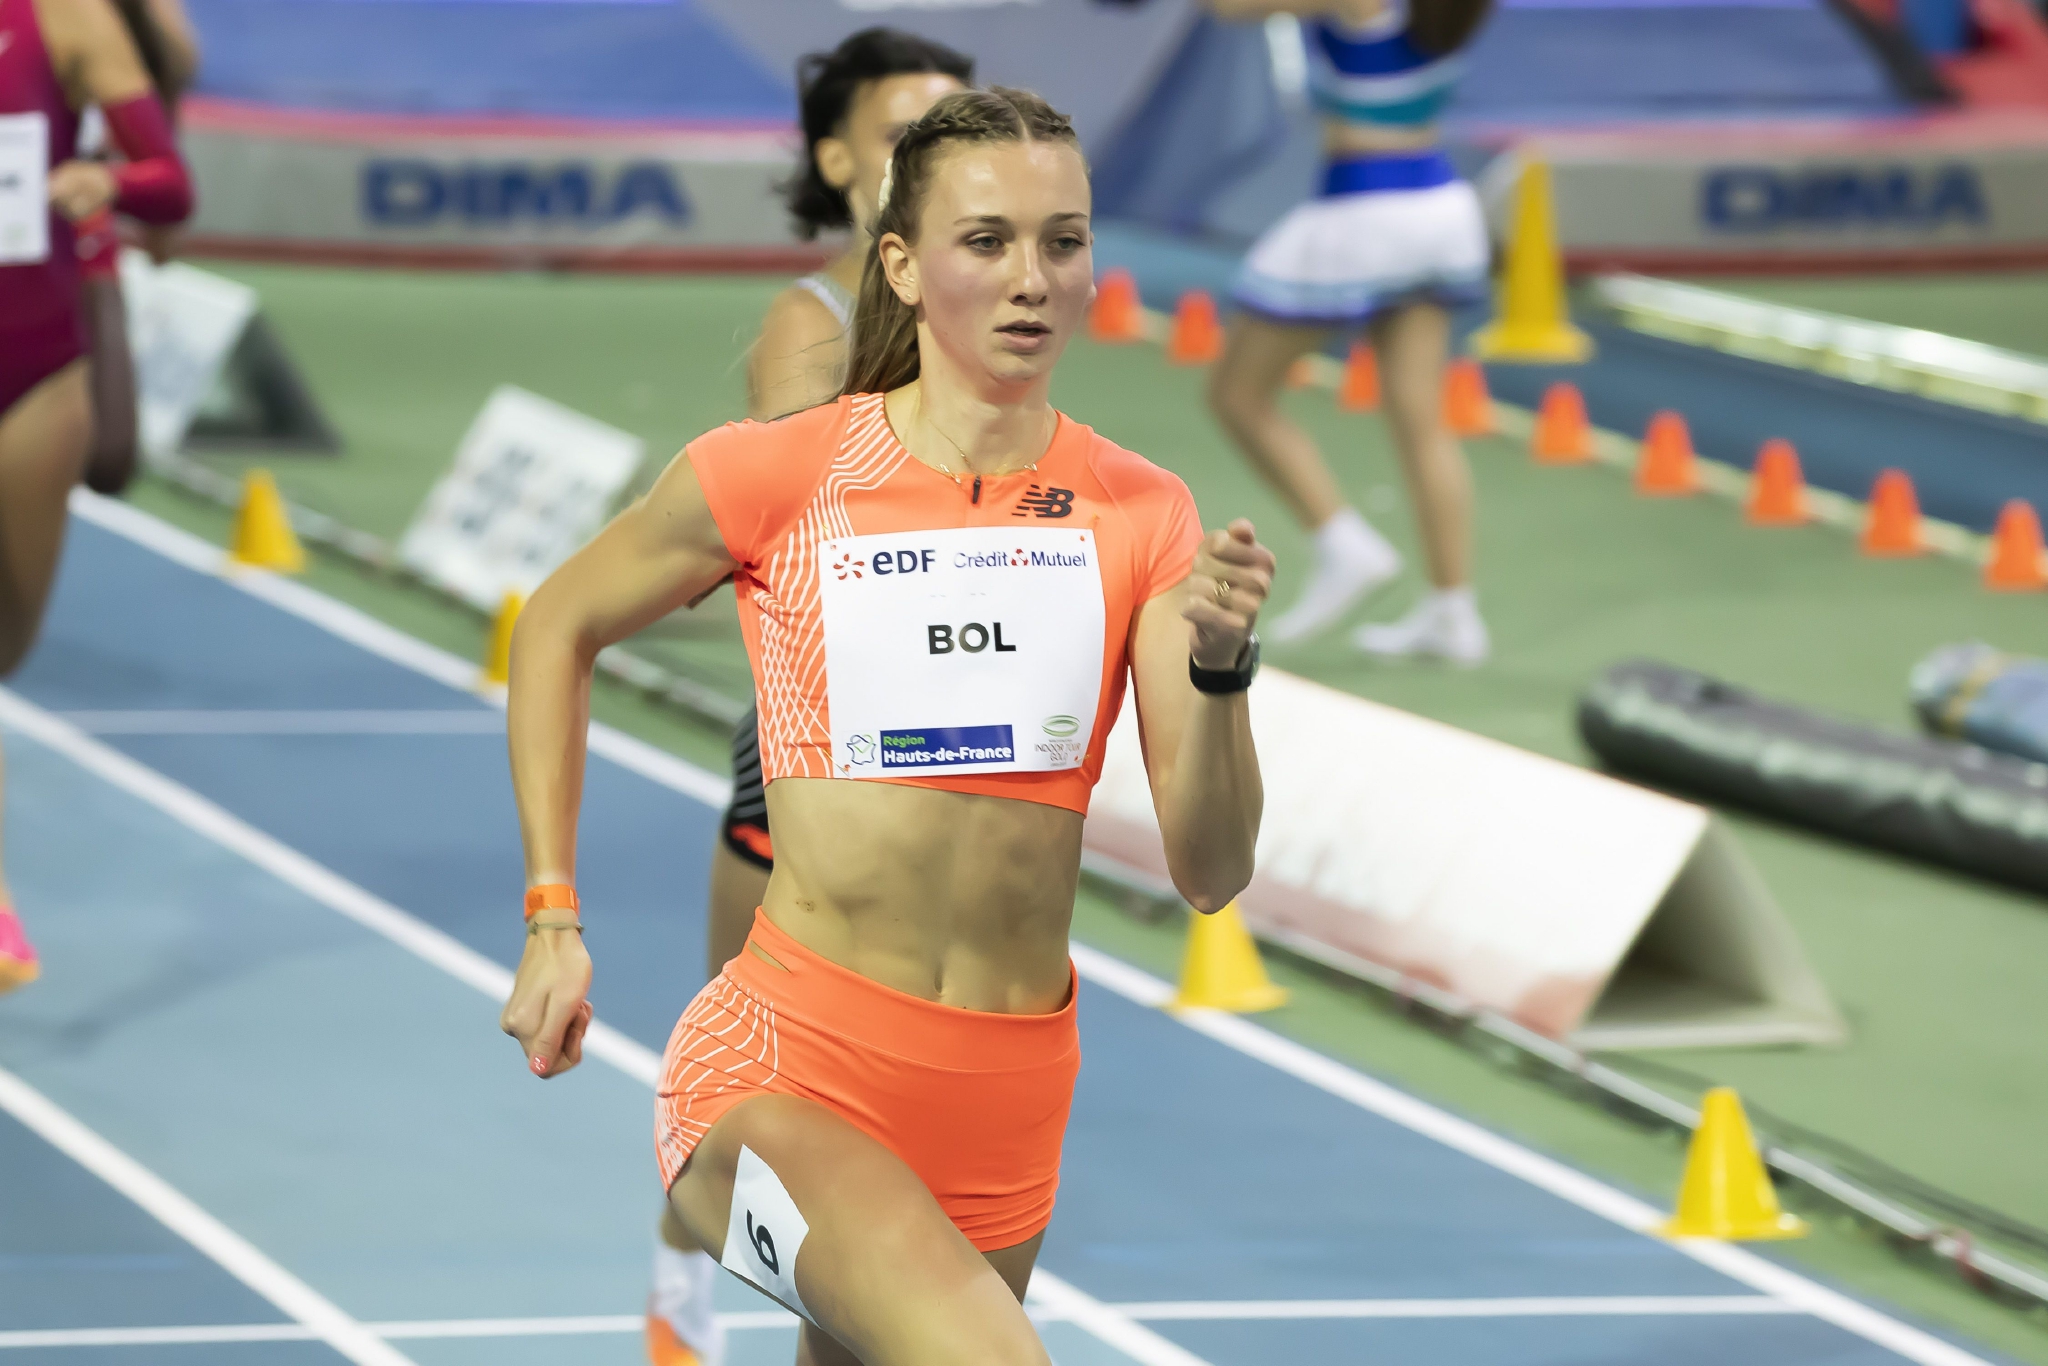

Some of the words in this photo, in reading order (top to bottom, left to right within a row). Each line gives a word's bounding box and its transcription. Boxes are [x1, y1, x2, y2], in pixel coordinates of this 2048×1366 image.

[362, 157, 690, 228] DIMA
[953, 551, 1008, 568] Crédit
[1031, 550, 1087, 567] Mutuel
[927, 622, 1016, 655] BOL
[883, 735, 925, 747] Région
[883, 746, 1012, 764] Hauts-de-France
[746, 1208, 780, 1276] 6
